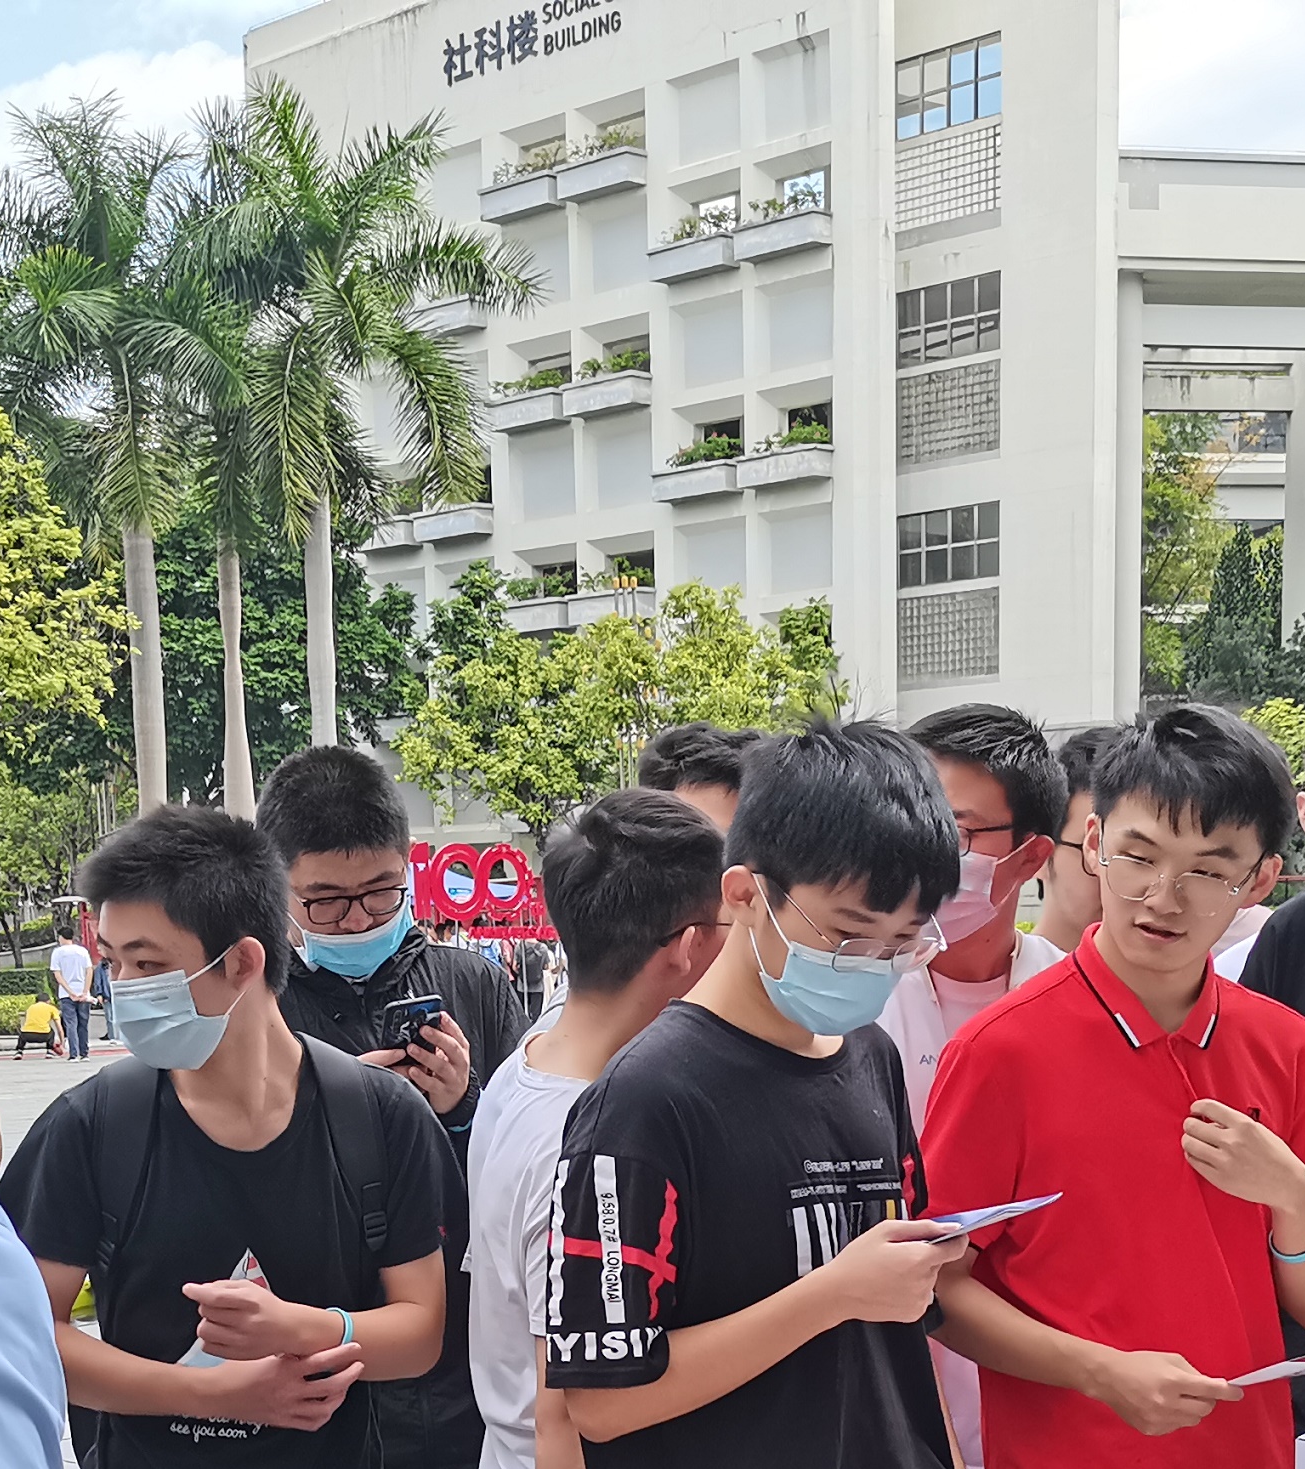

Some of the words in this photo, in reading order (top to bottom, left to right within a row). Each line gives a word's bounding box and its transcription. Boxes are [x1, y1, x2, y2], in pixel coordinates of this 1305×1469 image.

[443, 9, 539, 88] 社科楼
[543, 10, 622, 56] BUILDING
[169, 1421, 191, 1435] see
[192, 1423, 216, 1443] you
[217, 1427, 248, 1439] soon
